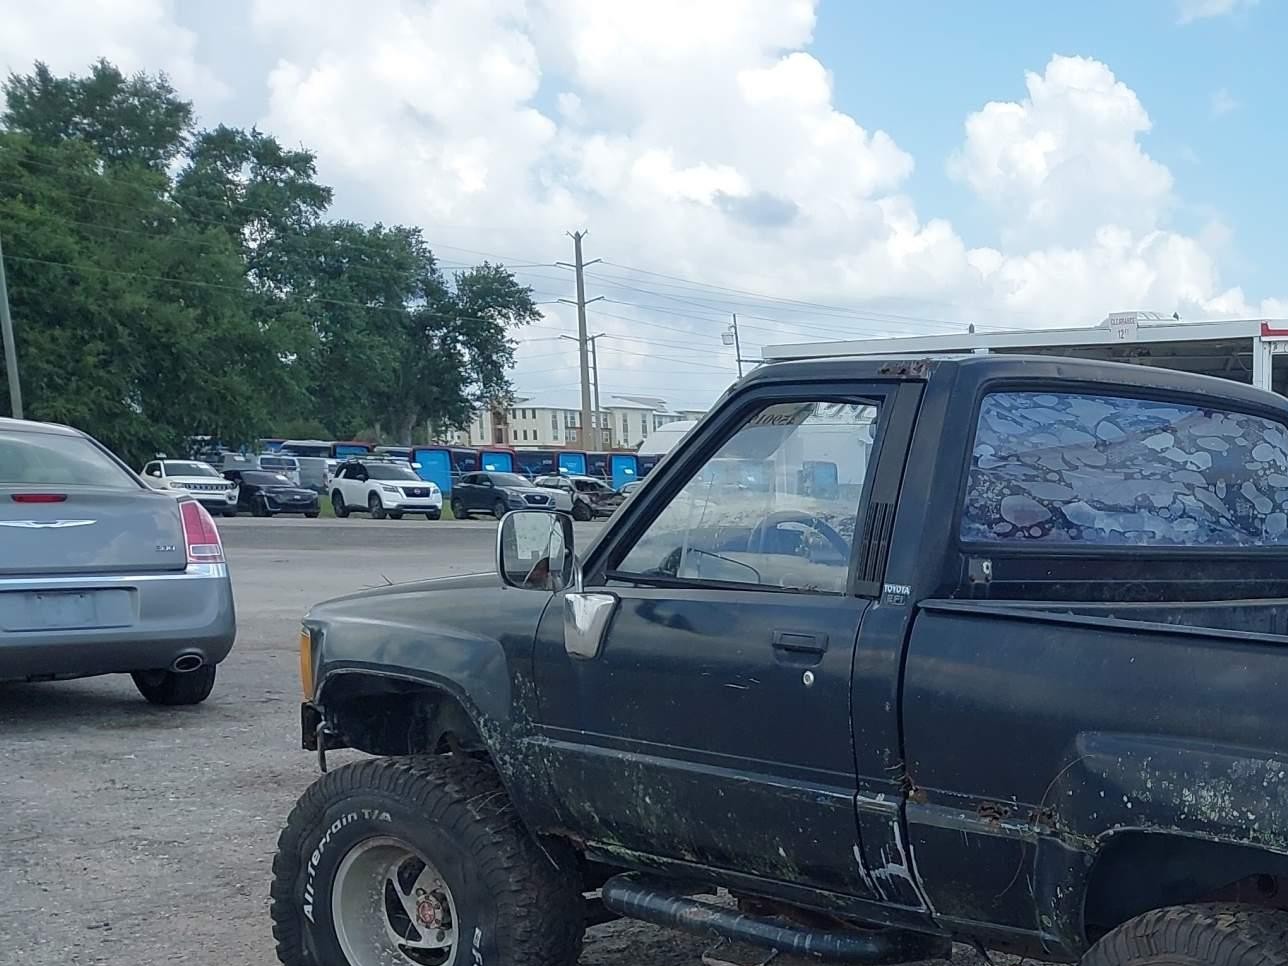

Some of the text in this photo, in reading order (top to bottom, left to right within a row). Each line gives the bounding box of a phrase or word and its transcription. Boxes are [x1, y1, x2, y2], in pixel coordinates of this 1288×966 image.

[1111, 317, 1136, 326] CLEARANCE
[883, 583, 912, 595] TOYOTA
[303, 809, 392, 924] All-Terrain T/A
